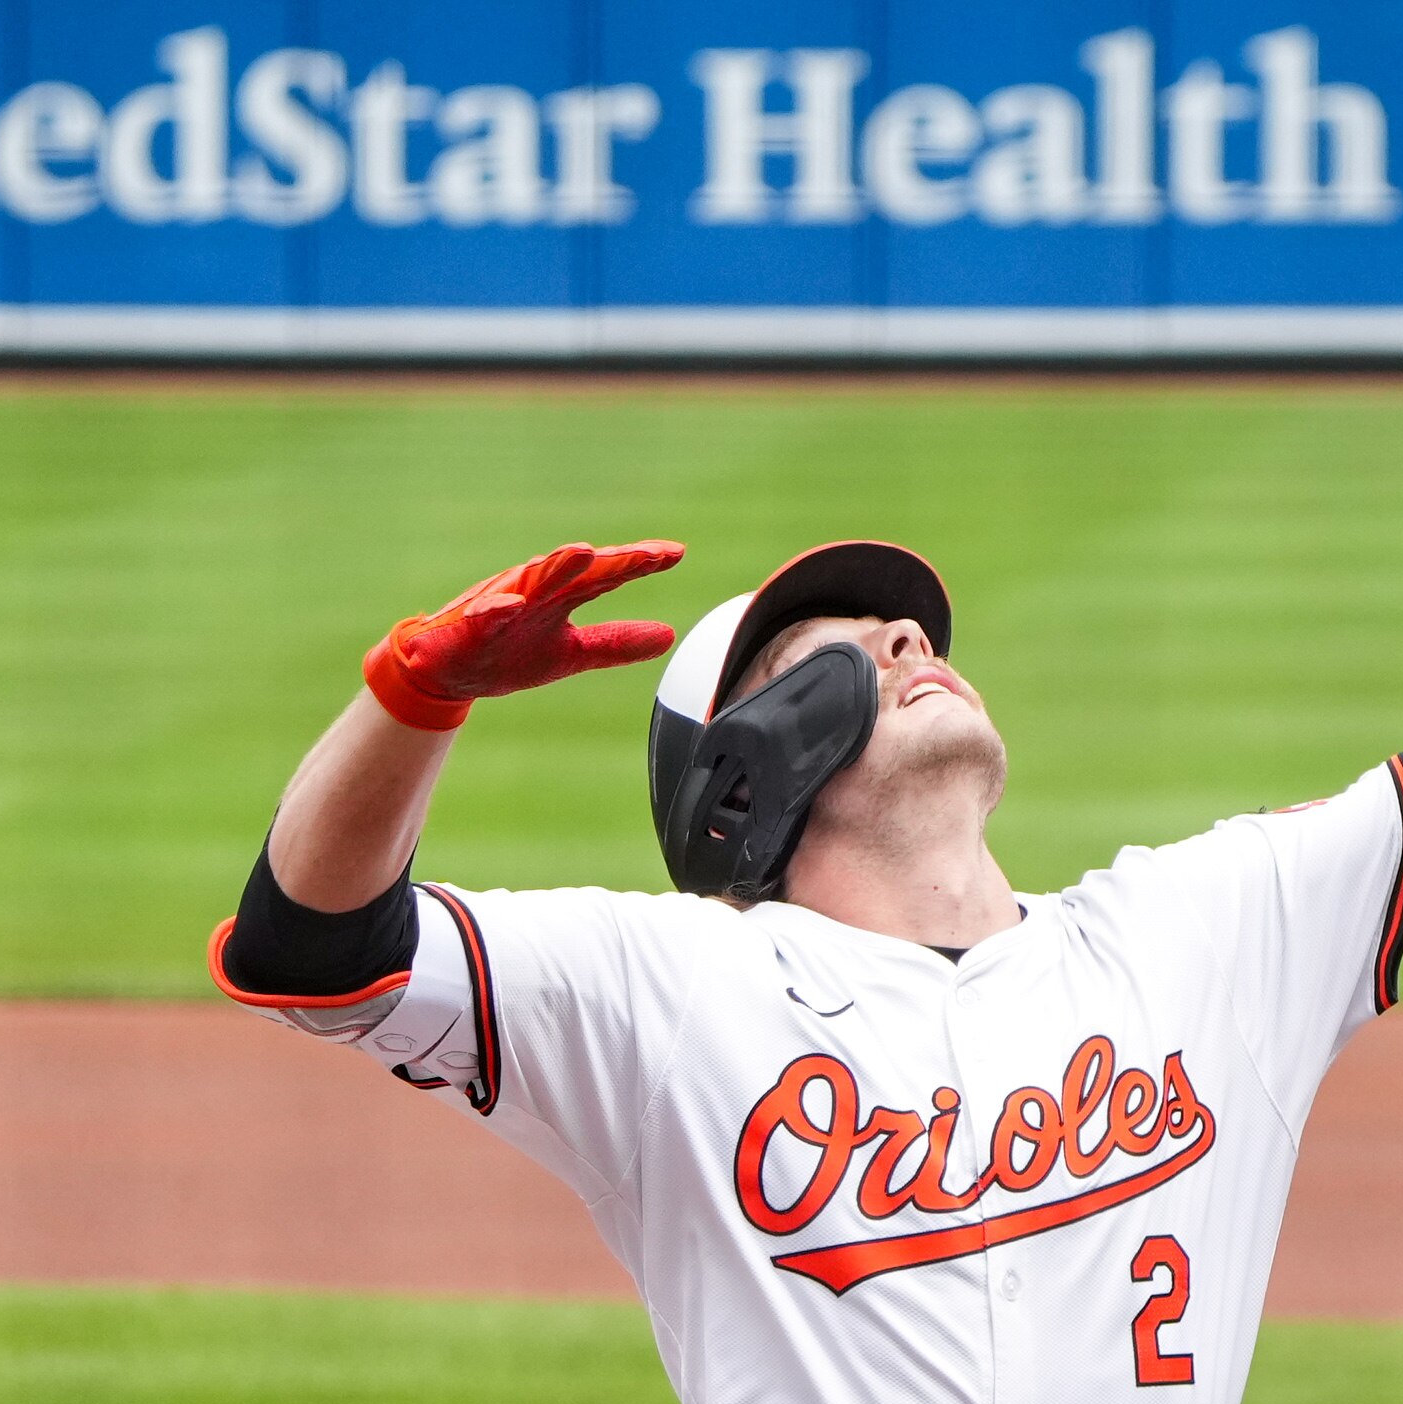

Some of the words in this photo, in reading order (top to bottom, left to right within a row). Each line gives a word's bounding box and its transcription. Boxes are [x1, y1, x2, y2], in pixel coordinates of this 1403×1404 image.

[686, 24, 1403, 227] Health
[734, 1034, 1216, 1238] Orioles
[1131, 1234, 1194, 1387] 2
